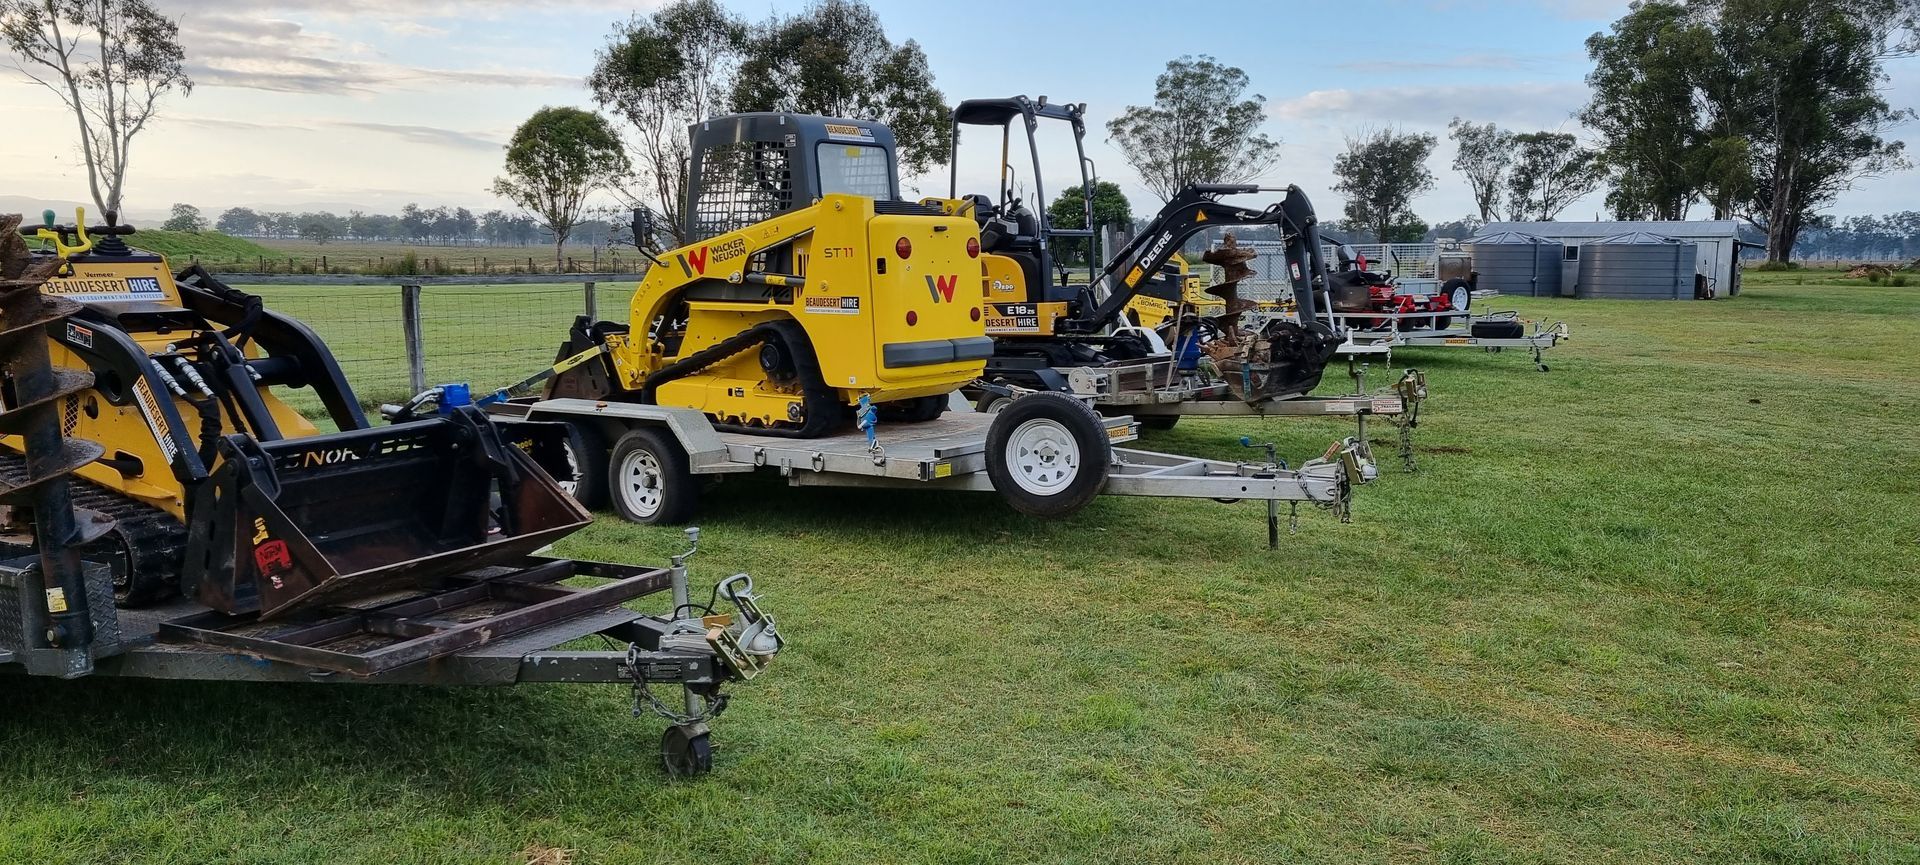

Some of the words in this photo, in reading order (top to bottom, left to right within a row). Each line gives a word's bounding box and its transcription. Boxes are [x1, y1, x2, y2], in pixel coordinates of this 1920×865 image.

[710, 238, 745, 255] WACKER
[712, 246, 747, 264] NEUSON
[1140, 230, 1173, 269] DEERE
[46, 279, 126, 294] BEAUDESERT
[129, 278, 160, 292] HIRE
[806, 297, 841, 307] BEAUDESERT
[842, 298, 858, 308] HIRE
[1017, 318, 1037, 327] HIRE
[137, 378, 168, 434] BEAUDESERT
[163, 433, 178, 458] HIRE
